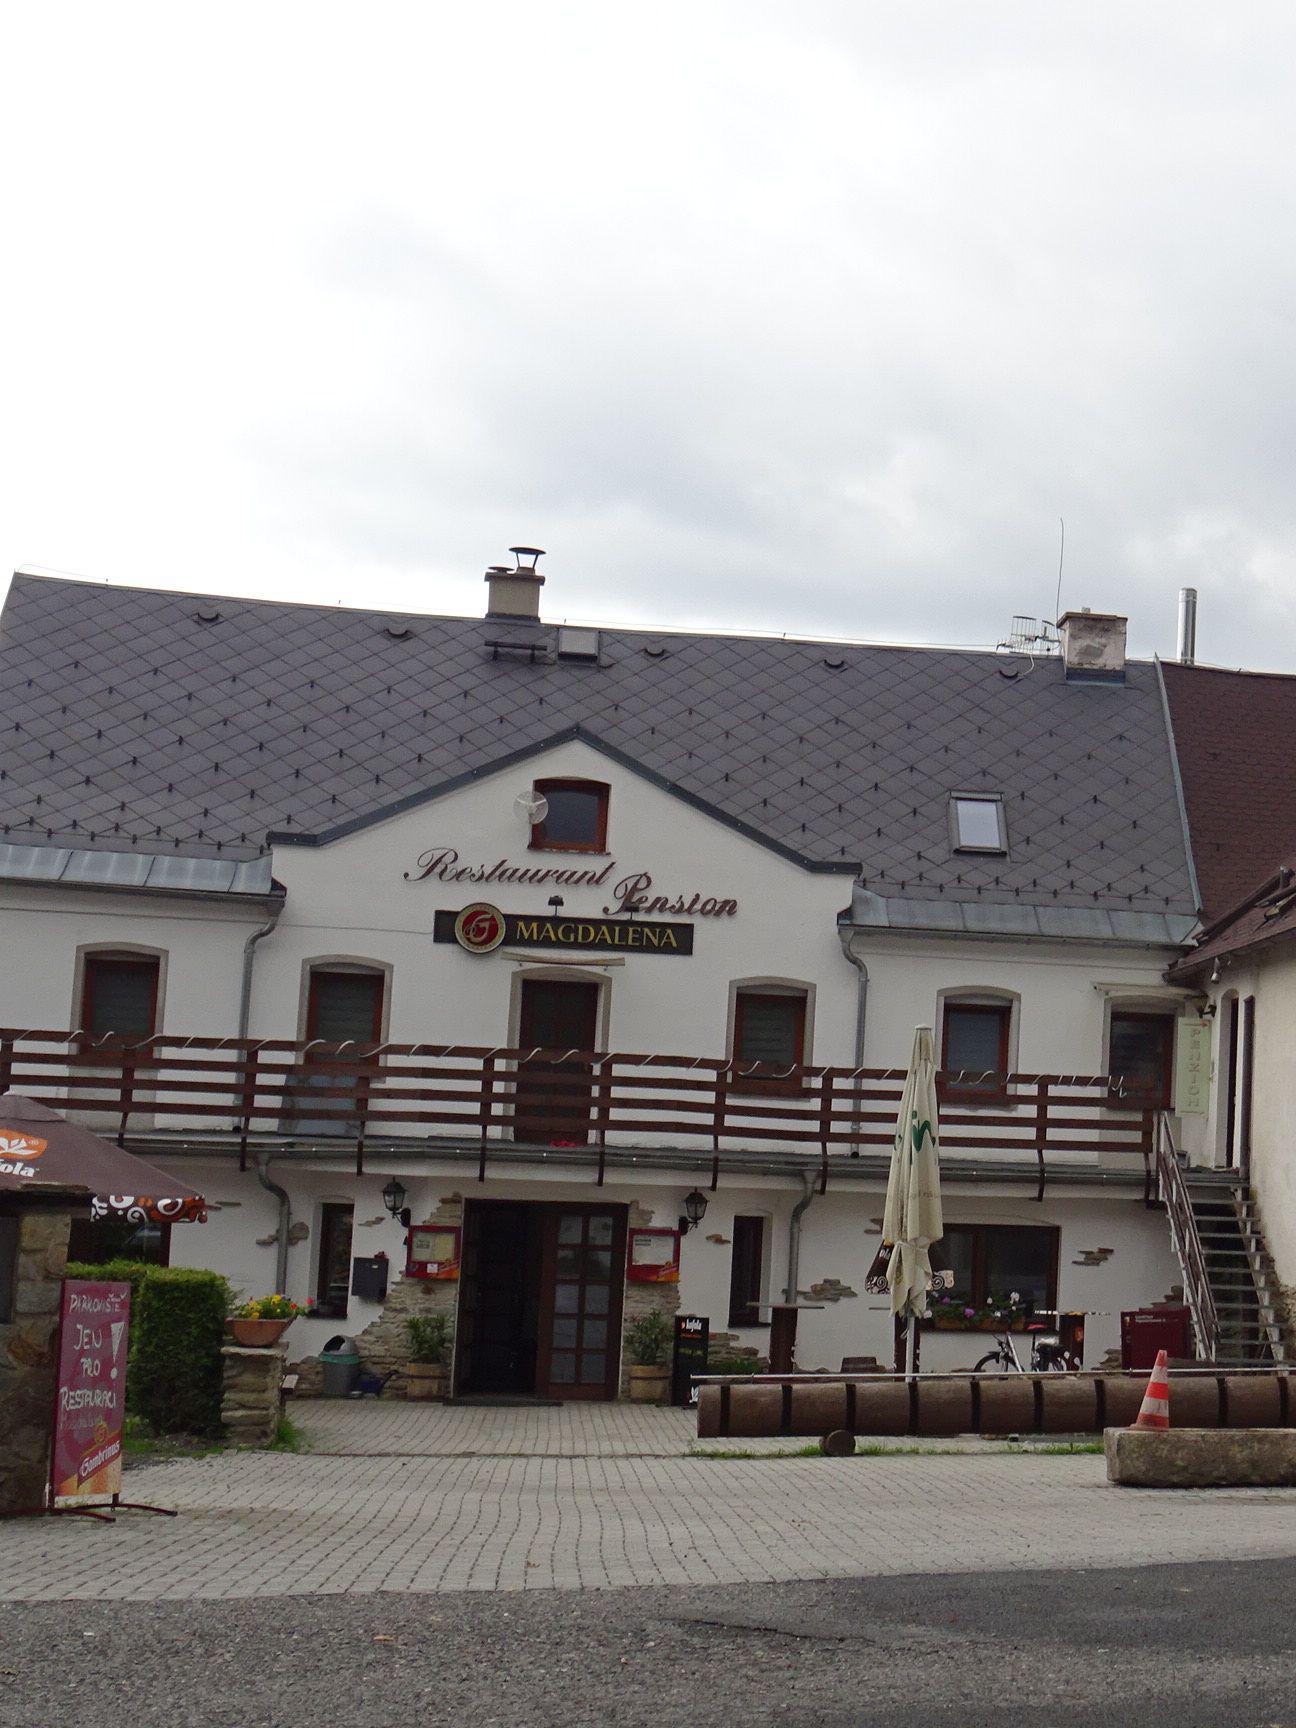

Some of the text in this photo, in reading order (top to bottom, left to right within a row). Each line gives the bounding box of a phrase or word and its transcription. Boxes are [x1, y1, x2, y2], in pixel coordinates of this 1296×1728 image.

[403, 847, 616, 886] Restaurant
[602, 872, 738, 917] Pension
[516, 920, 677, 948] MAGDALENA
[80, 1357, 101, 1377] PRO
[81, 1440, 120, 1477] Gambrinus
